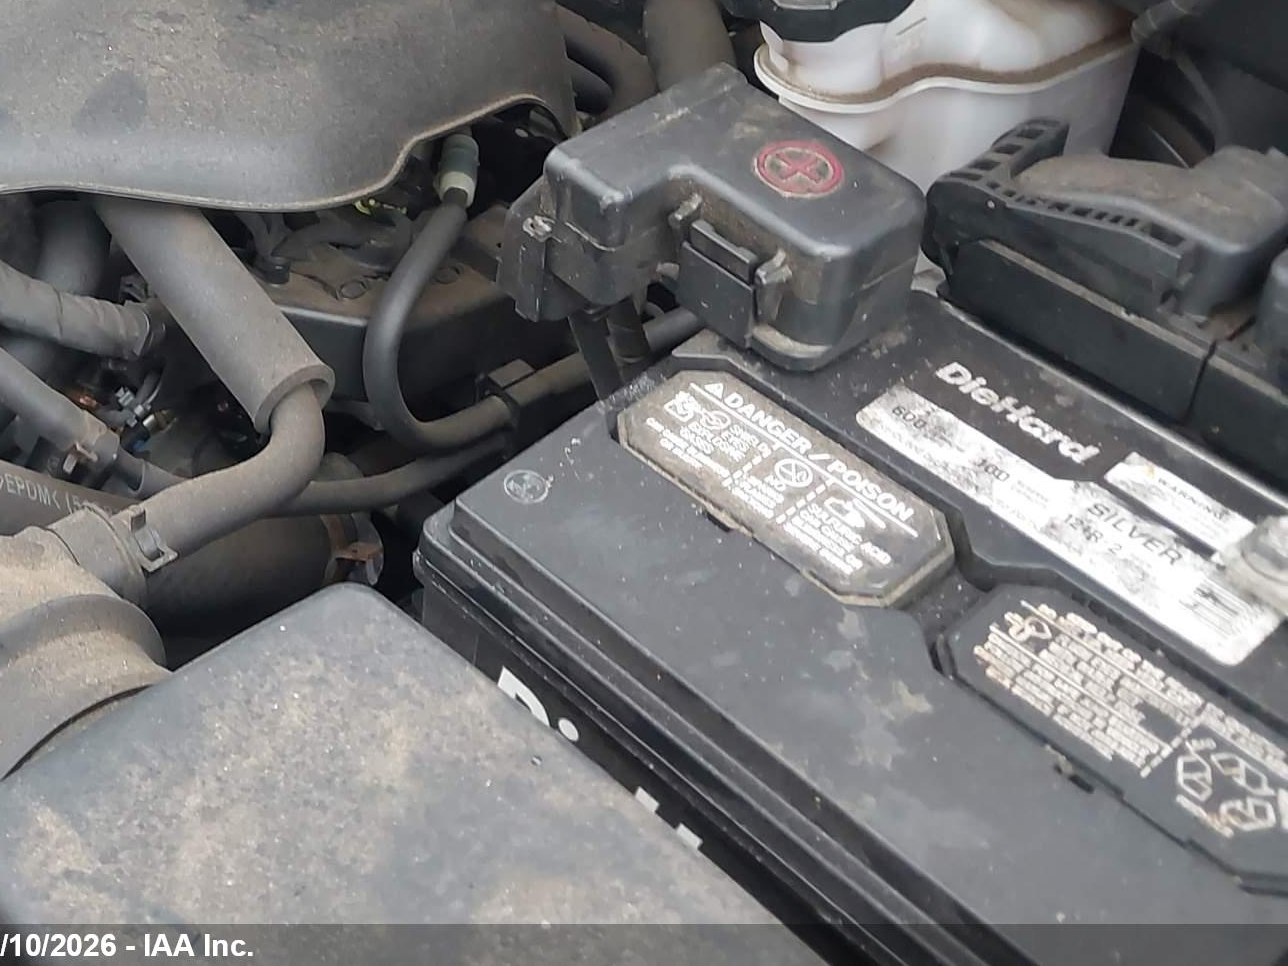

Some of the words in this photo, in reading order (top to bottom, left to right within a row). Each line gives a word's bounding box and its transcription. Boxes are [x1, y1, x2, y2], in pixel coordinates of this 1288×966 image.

[891, 405, 928, 430] 600
[936, 362, 1100, 464] DieHard
[722, 393, 813, 454] DANGER
[825, 460, 914, 522] POISON
[1086, 500, 1184, 566] SILVER
